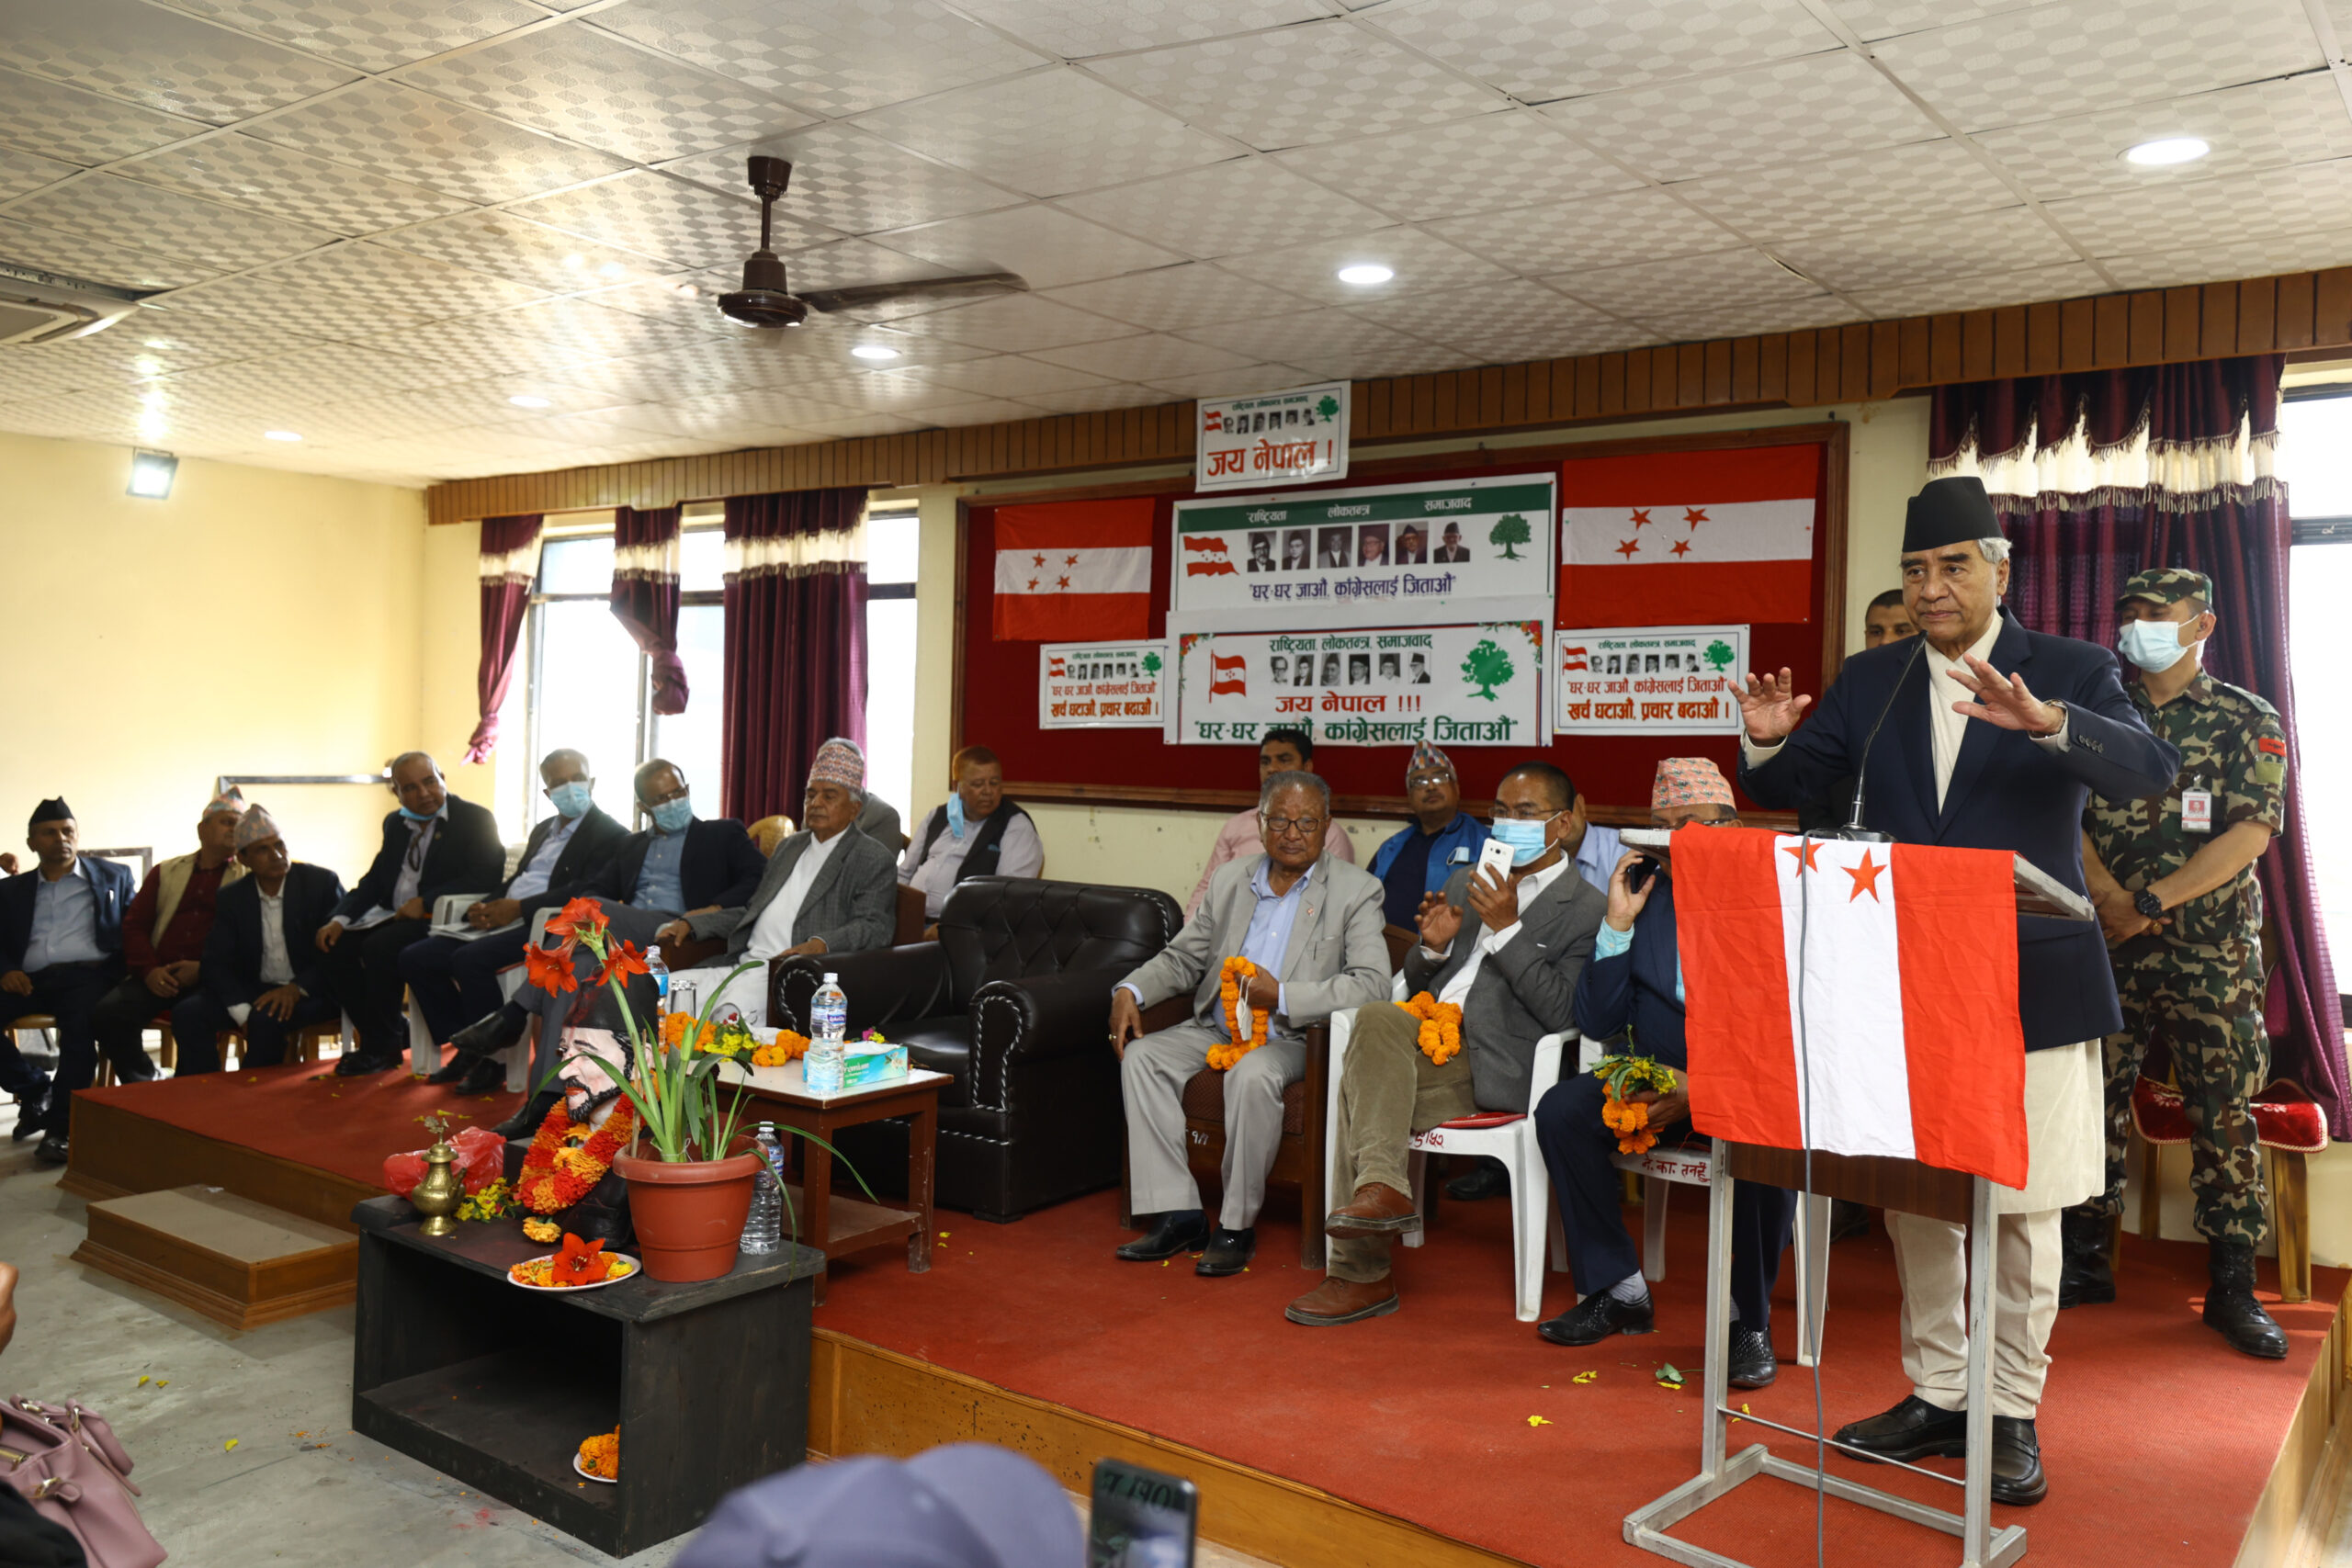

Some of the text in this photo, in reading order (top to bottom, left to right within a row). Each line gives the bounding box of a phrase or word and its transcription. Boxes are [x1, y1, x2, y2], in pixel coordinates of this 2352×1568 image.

[1207, 438, 1332, 476] जय नेपाल !
[1275, 691, 1420, 713] जय नेपाल !!!
[1567, 697, 1591, 720] खर्च
[1641, 702, 1674, 721] प्रचार
